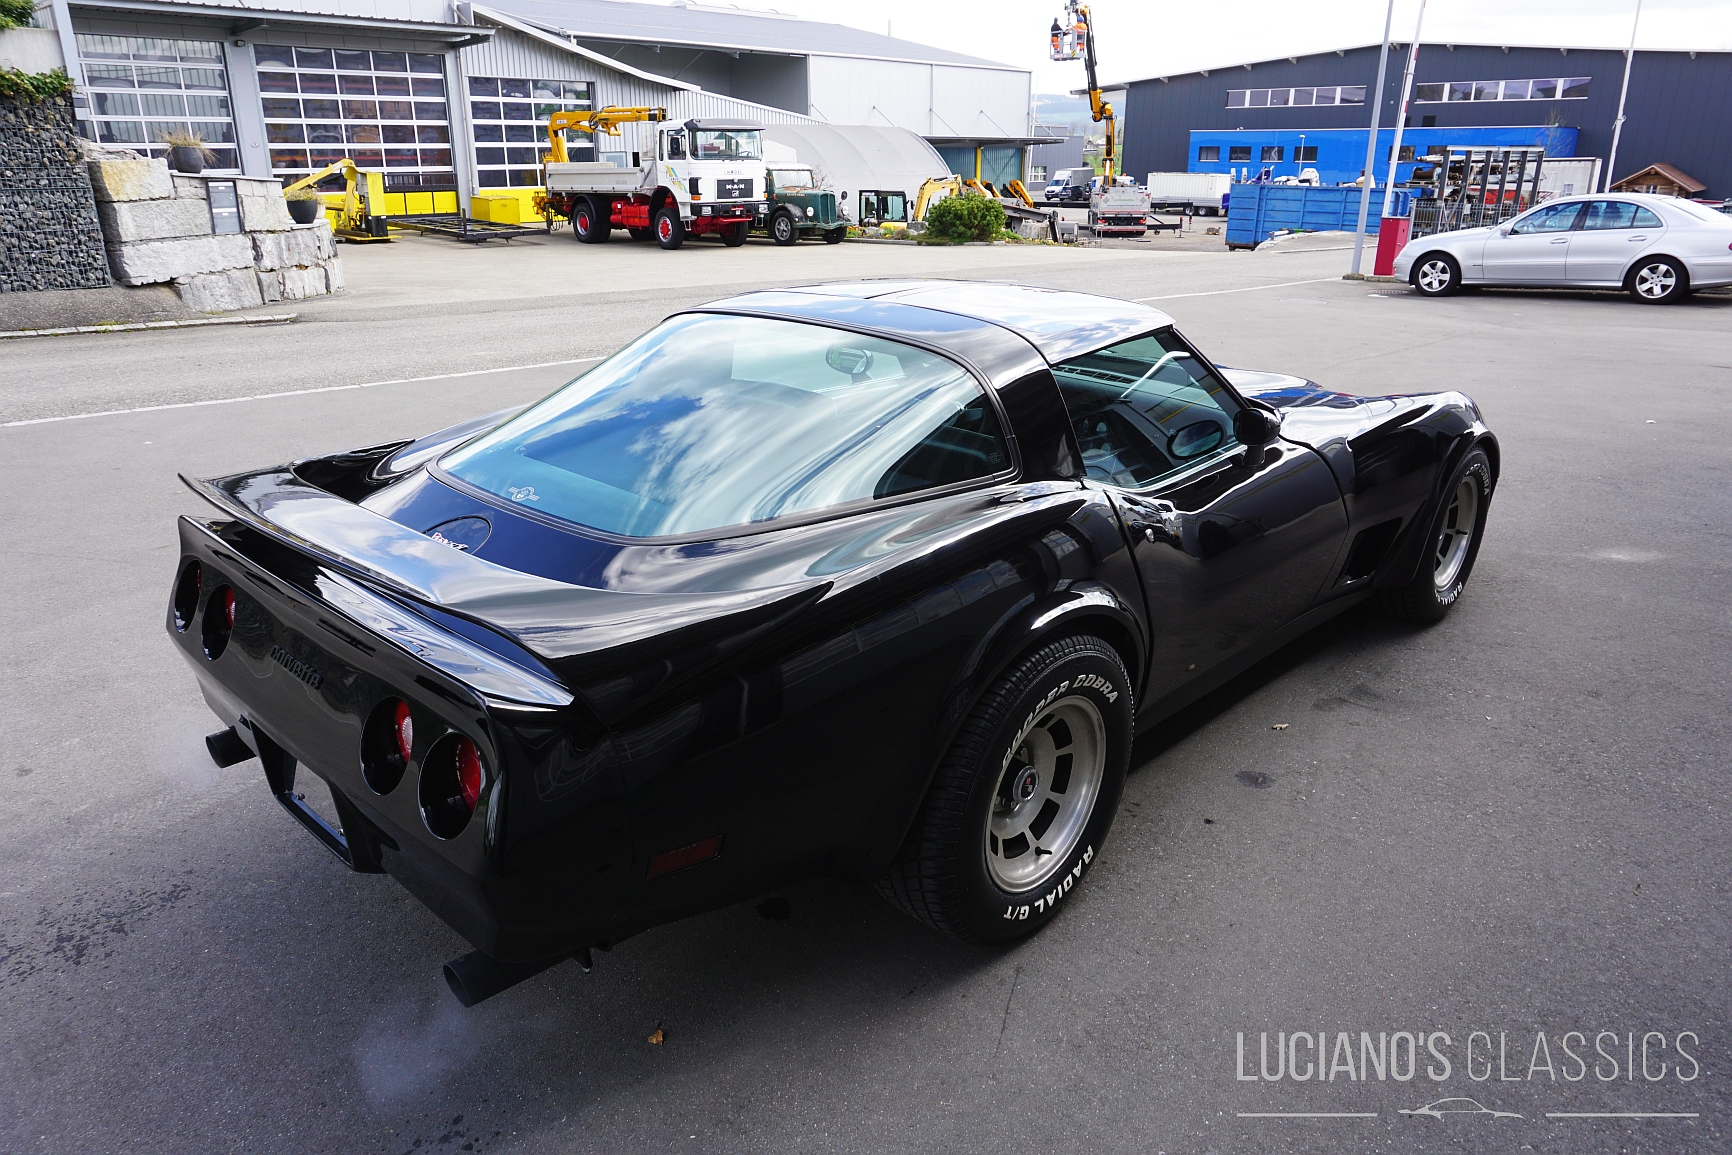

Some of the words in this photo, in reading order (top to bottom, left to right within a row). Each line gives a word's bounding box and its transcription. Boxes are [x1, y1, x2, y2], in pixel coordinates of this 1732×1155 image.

[1479, 464, 1490, 496] COBRA
[1441, 581, 1463, 606] RADIAL
[1072, 674, 1119, 704] COBRA
[1034, 845, 1094, 913] RADIAL
[1003, 905, 1030, 921] G/T
